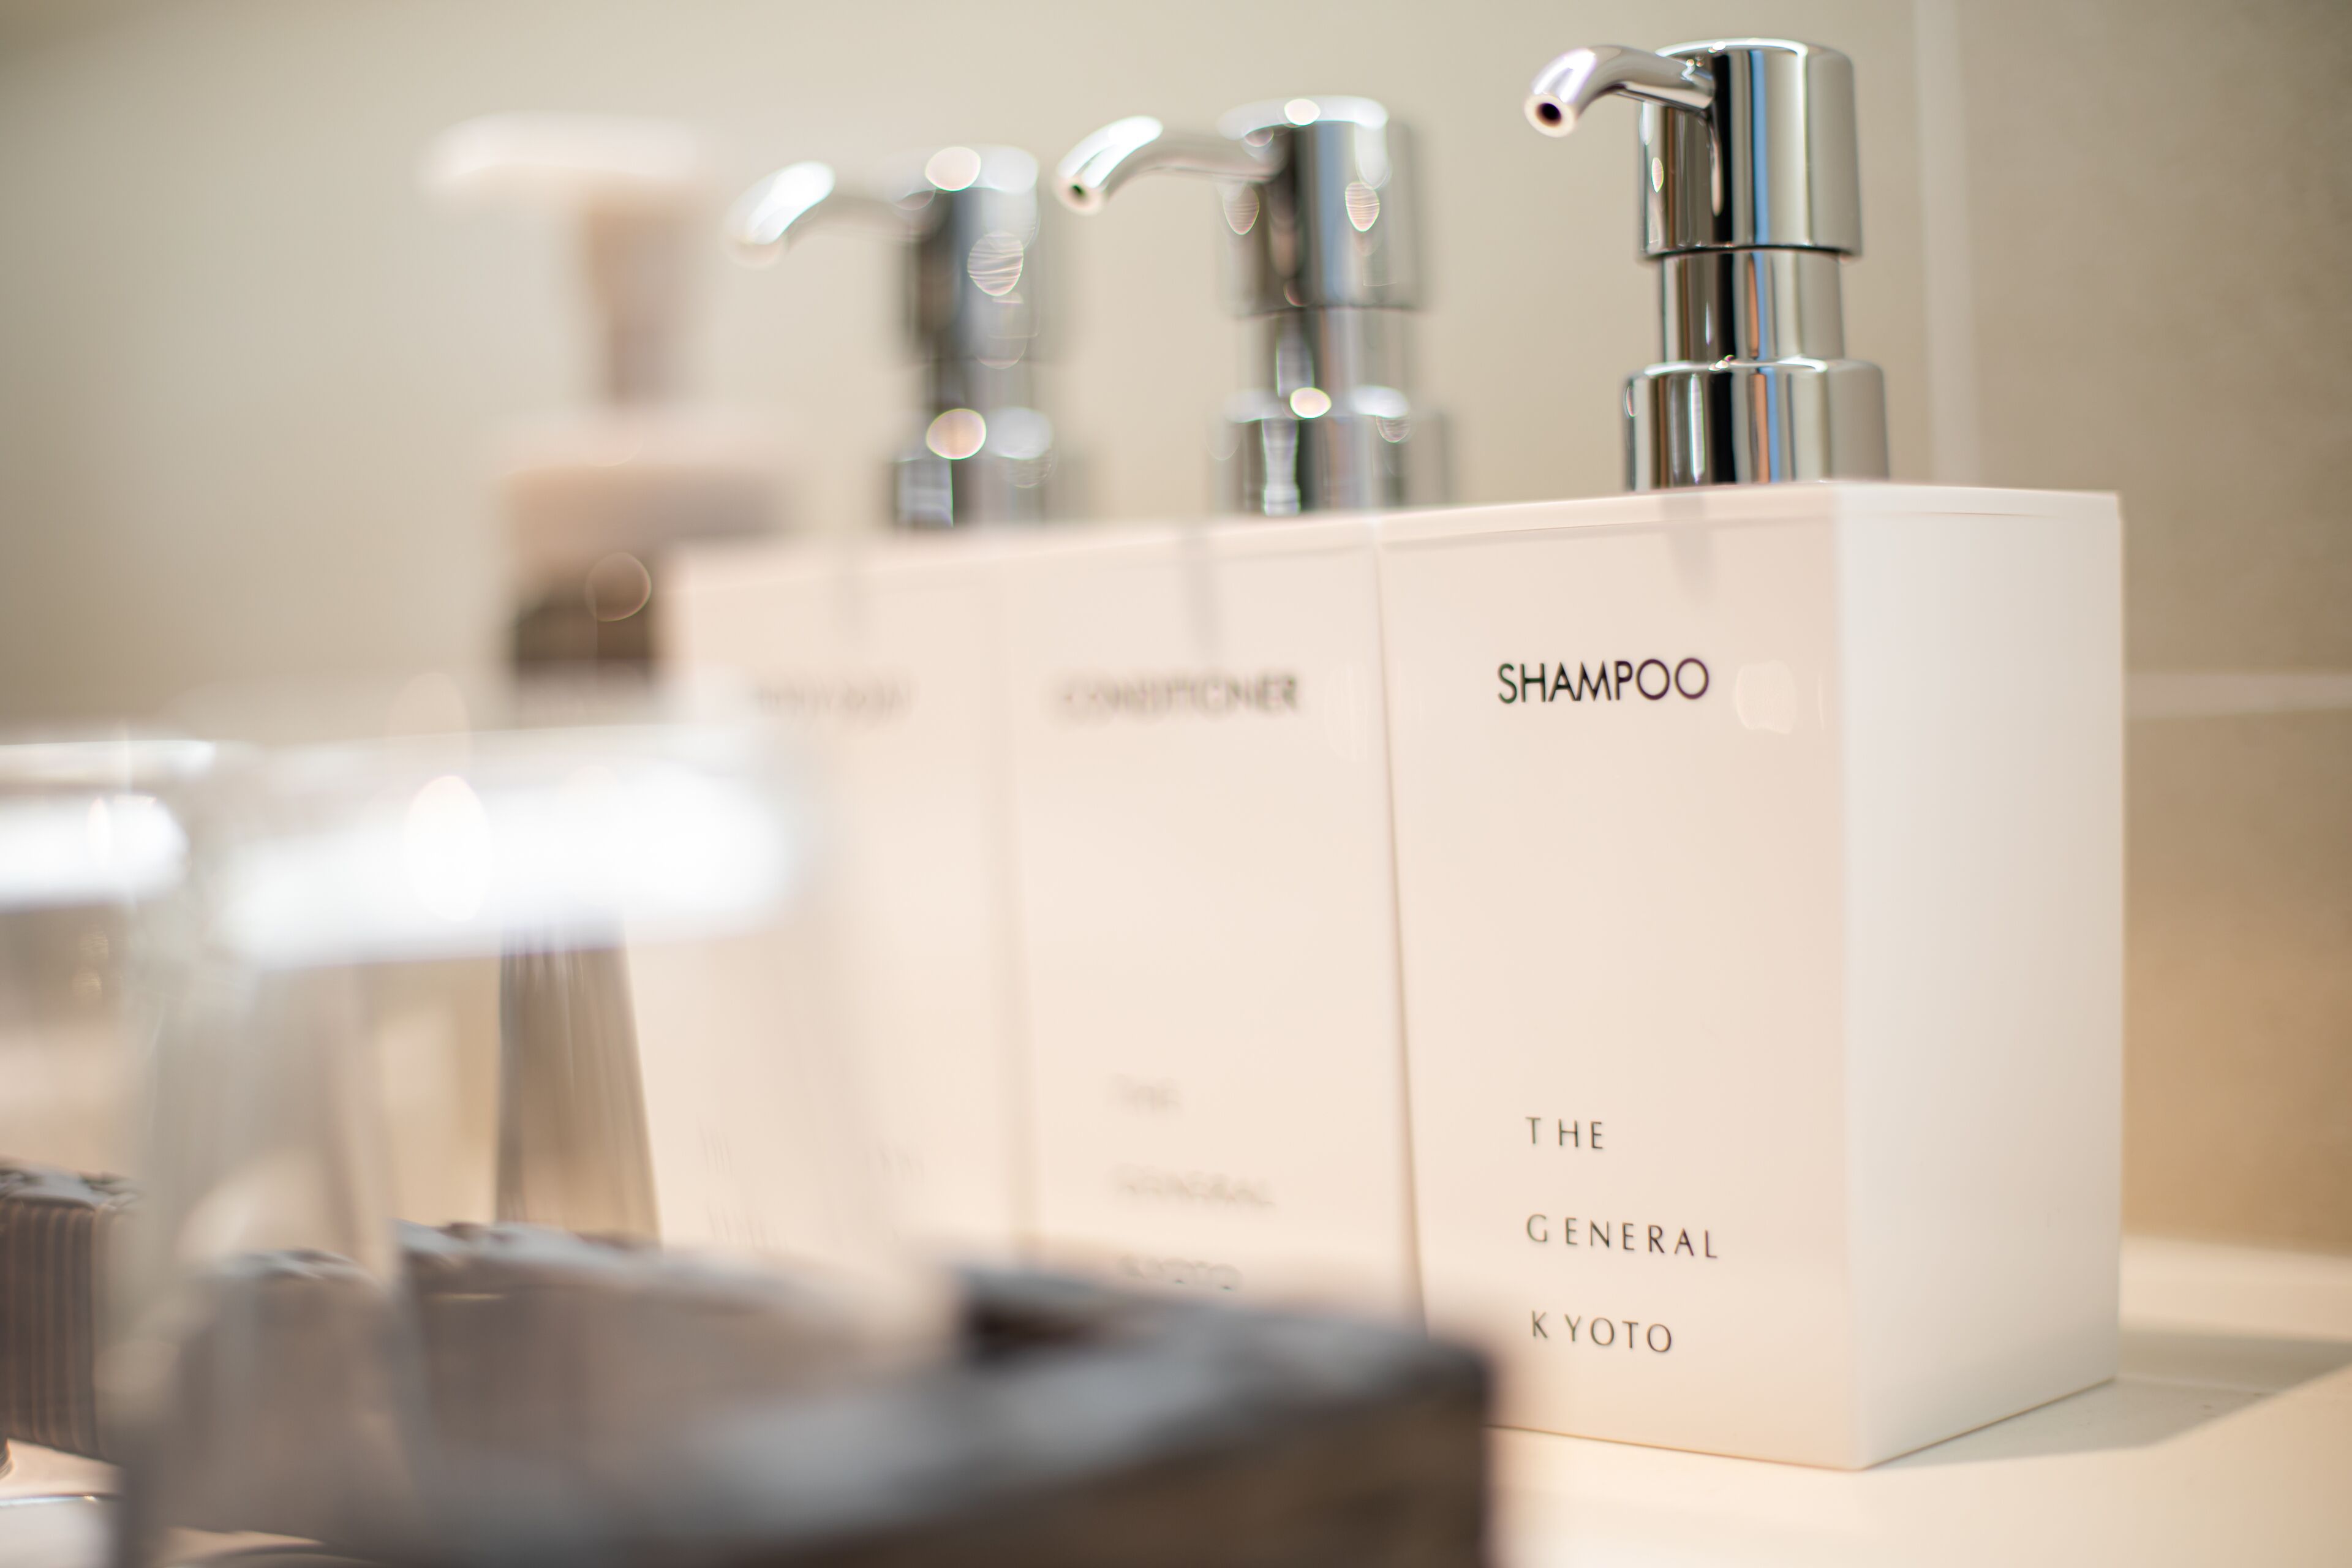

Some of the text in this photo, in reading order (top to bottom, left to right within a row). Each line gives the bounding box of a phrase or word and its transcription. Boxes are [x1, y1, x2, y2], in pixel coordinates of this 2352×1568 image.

[1498, 657, 1709, 704] SHAMPOO
[1525, 1117, 1604, 1150] THE
[1526, 1213, 1718, 1259] GENERAL
[1531, 1310, 1672, 1354] KYOTO
